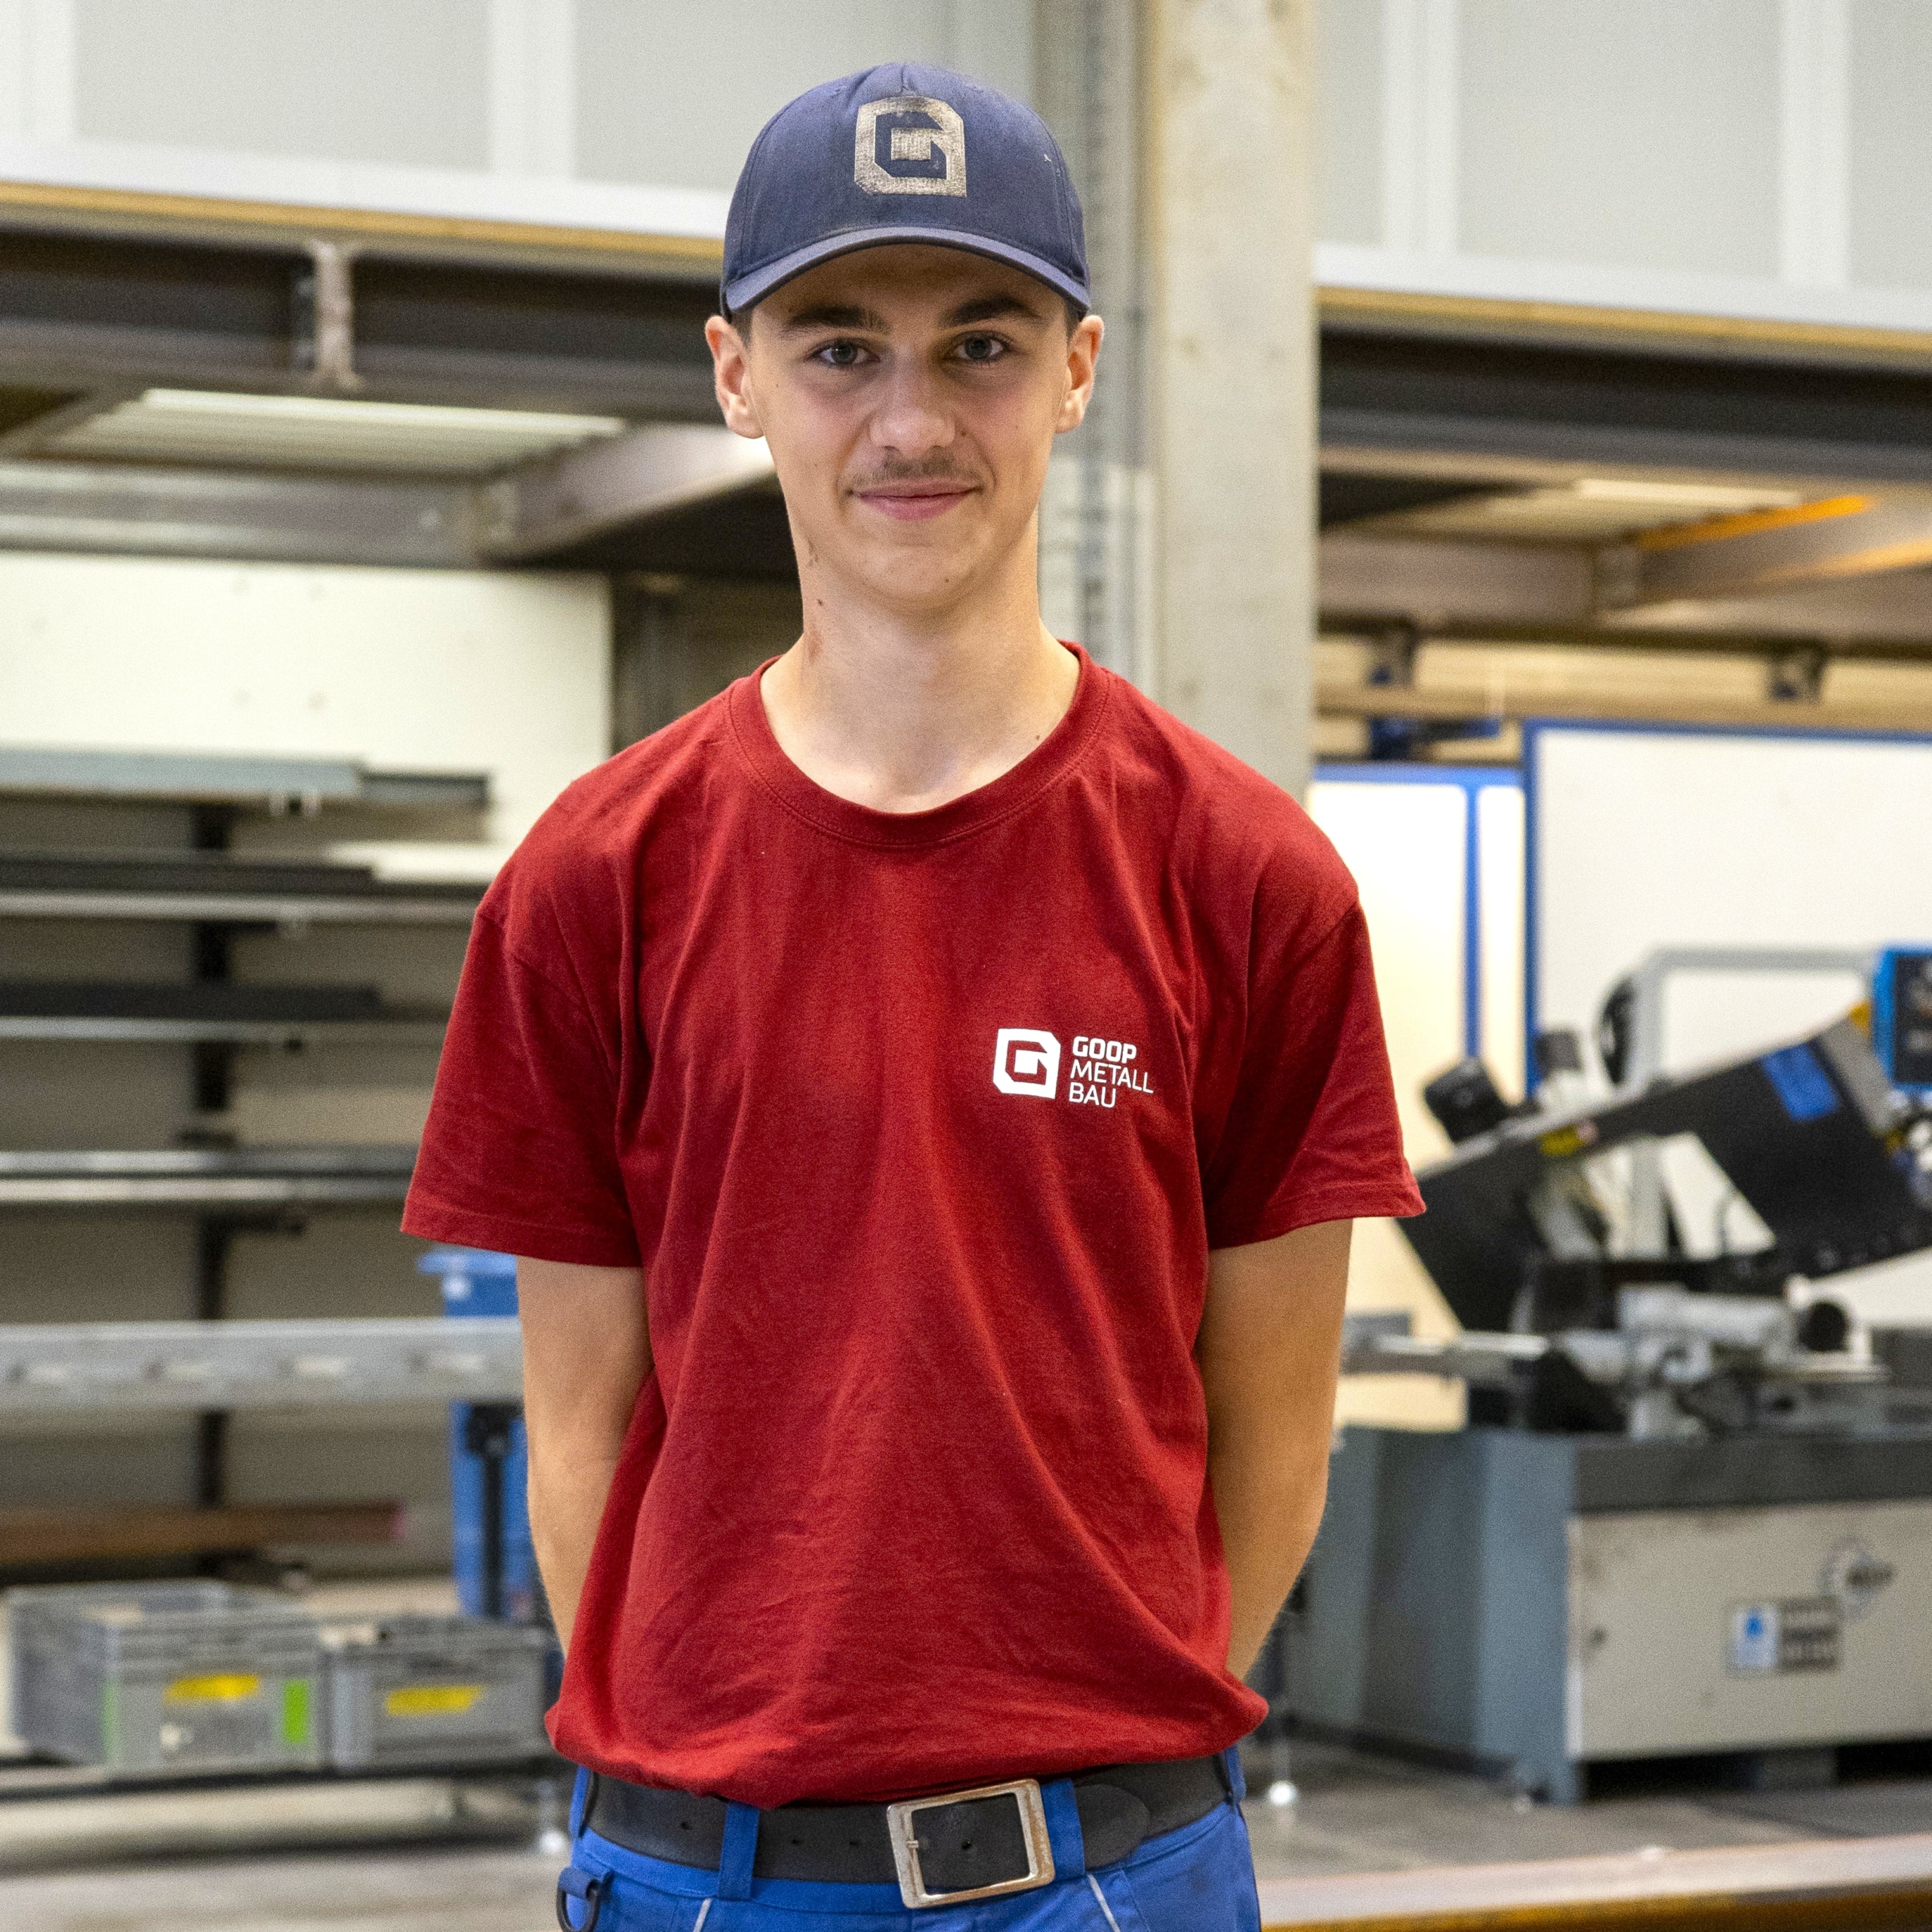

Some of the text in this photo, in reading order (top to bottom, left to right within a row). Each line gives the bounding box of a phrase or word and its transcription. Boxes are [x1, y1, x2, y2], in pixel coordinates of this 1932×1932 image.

[1072, 1036, 1137, 1063] GOOP
[1070, 1059, 1154, 1094] METALL
[1069, 1082, 1116, 1108] BAU
